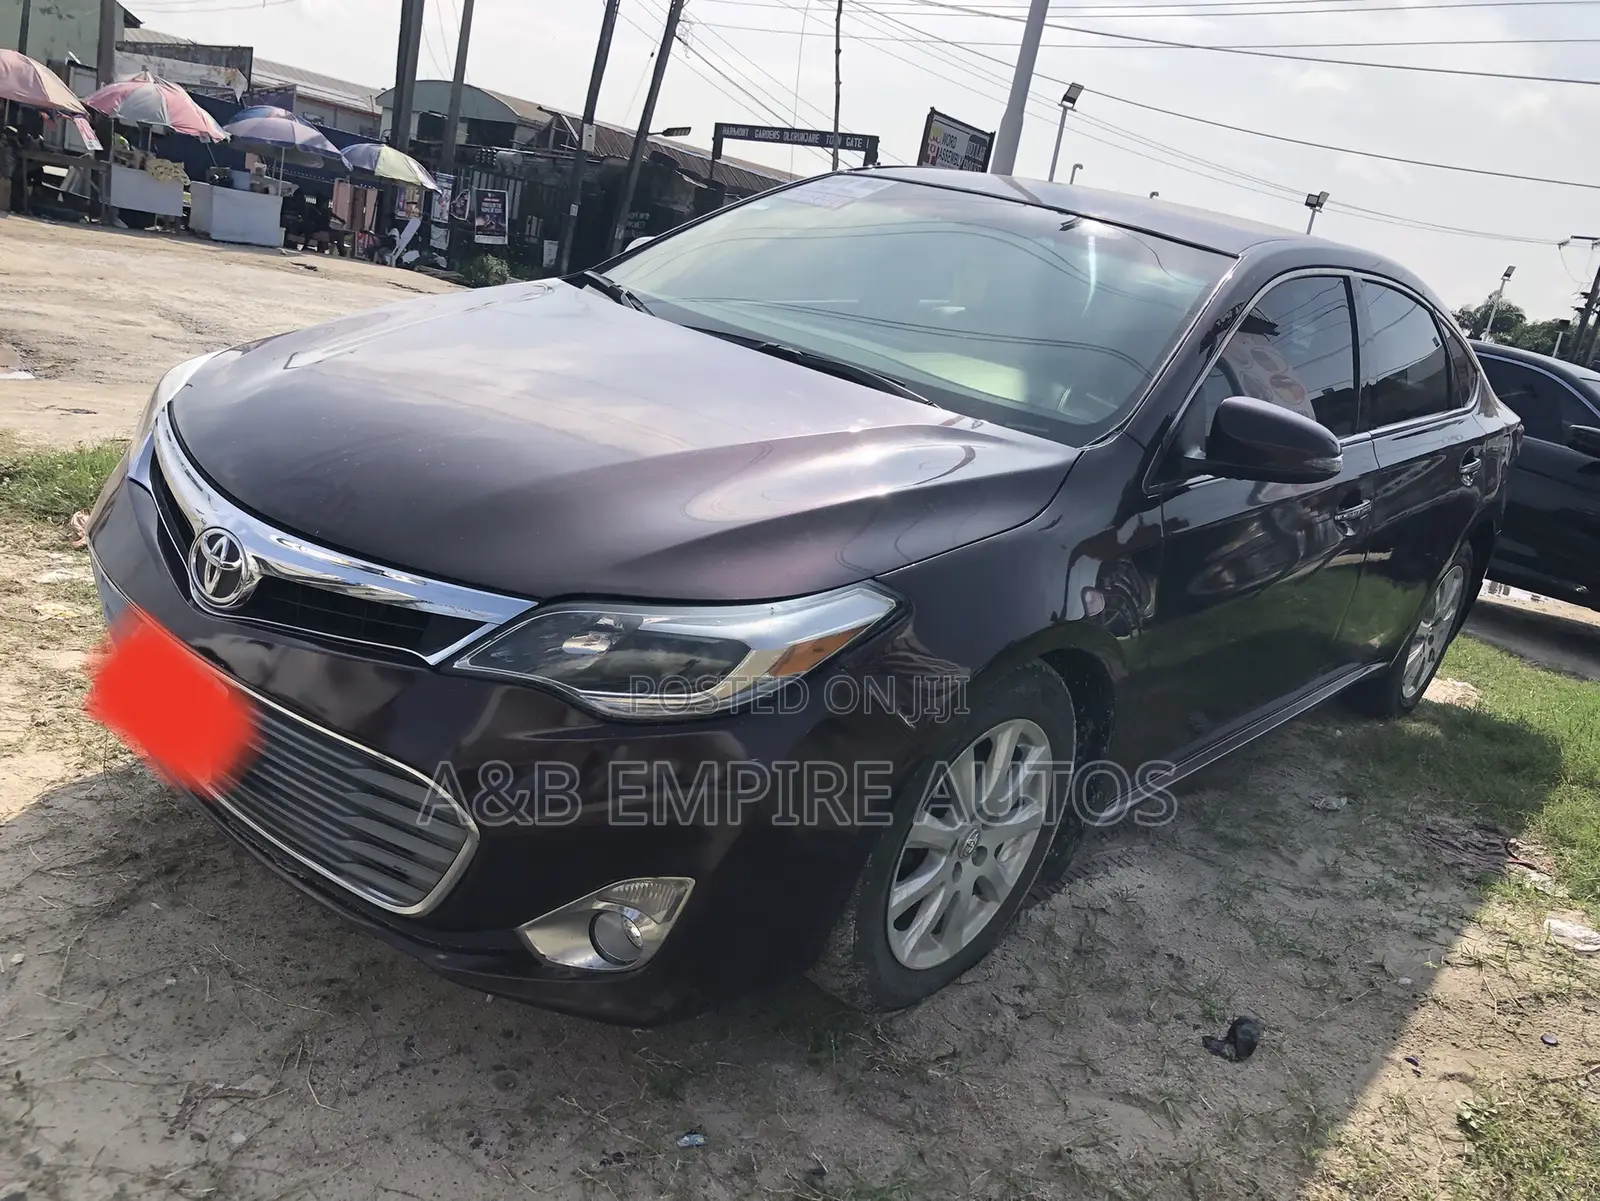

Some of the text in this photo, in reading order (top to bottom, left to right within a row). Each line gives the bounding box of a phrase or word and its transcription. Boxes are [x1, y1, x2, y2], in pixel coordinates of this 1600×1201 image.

[754, 129, 780, 140] GARDENS
[826, 134, 842, 145] TON
[846, 136, 862, 148] GATE
